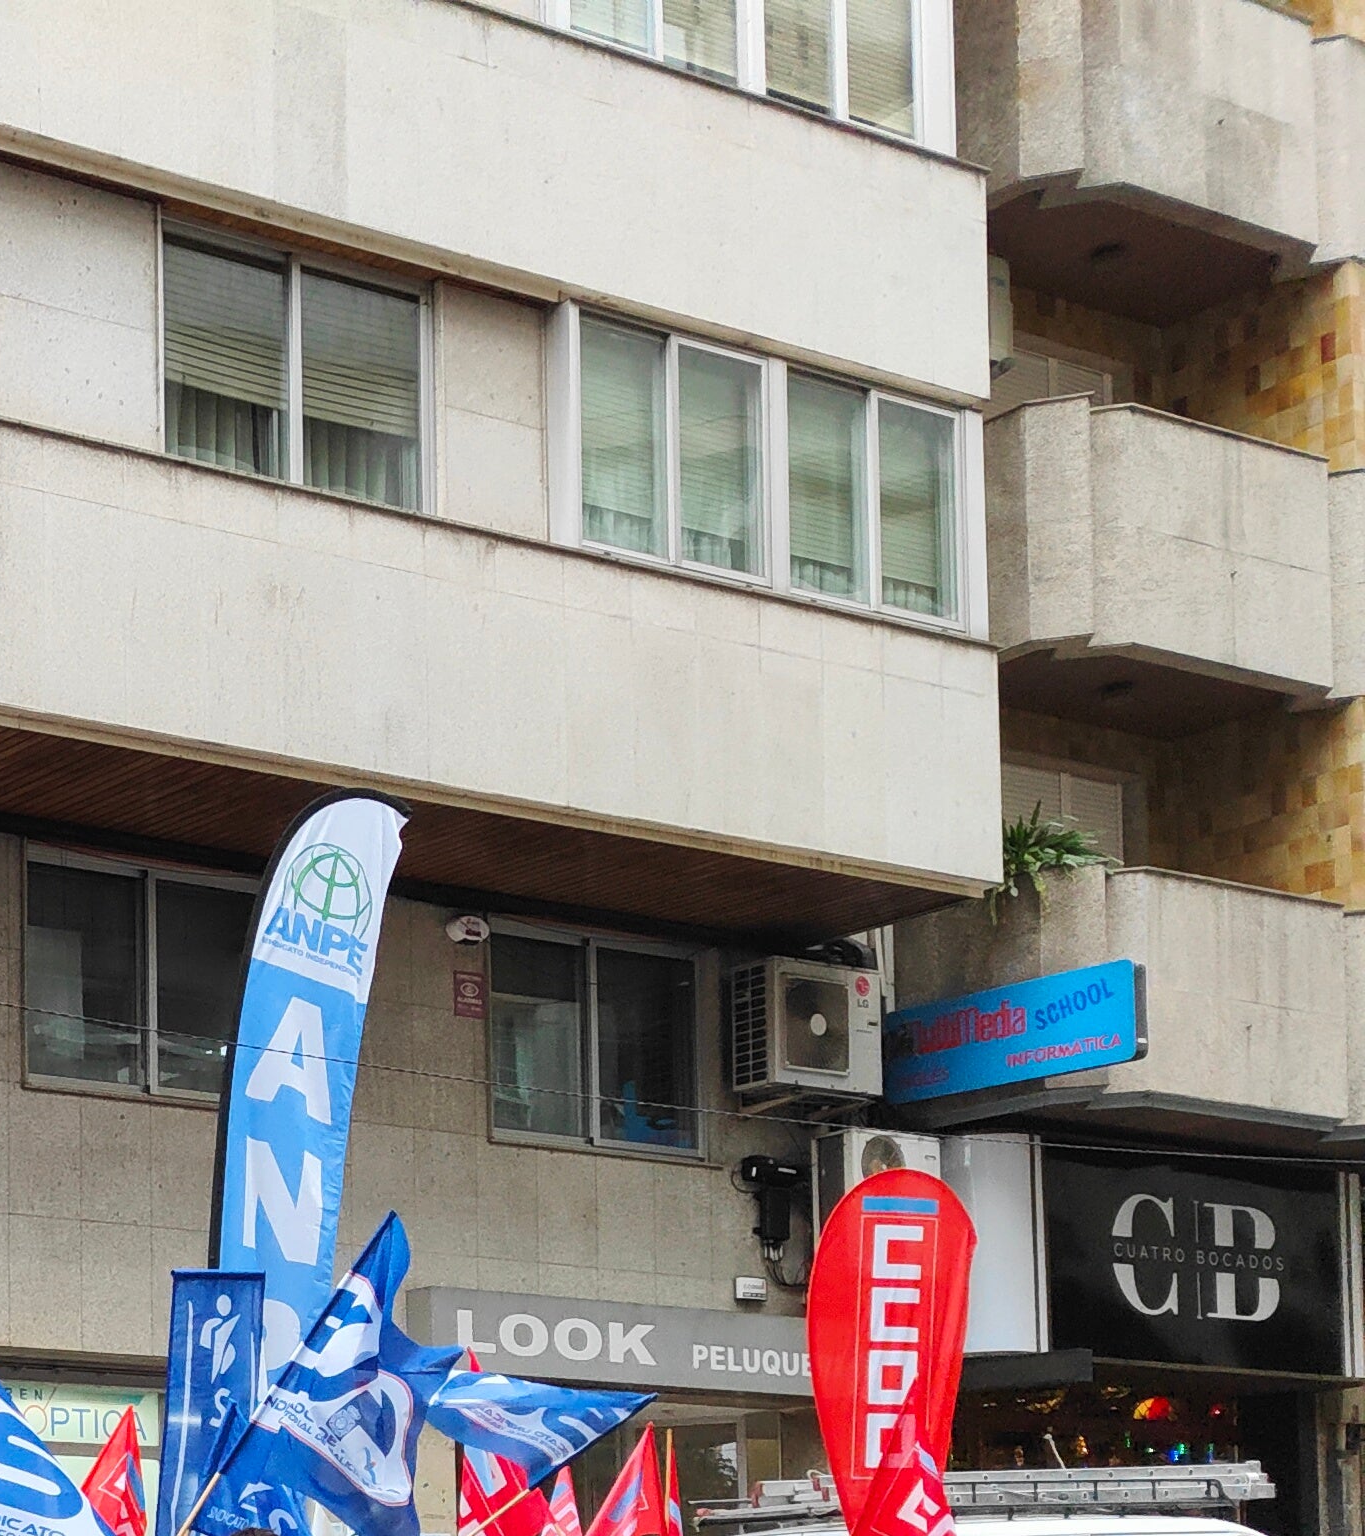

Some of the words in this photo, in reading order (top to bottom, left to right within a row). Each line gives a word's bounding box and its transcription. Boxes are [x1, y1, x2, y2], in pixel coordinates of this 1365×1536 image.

[265, 906, 368, 975] ANPE
[857, 999, 869, 1008] LG
[1035, 977, 1115, 1030] SCHOOL
[1114, 1243, 1185, 1263] CUATRO
[1196, 1250, 1284, 1271] BOCADOS
[457, 1309, 657, 1366] LOOK
